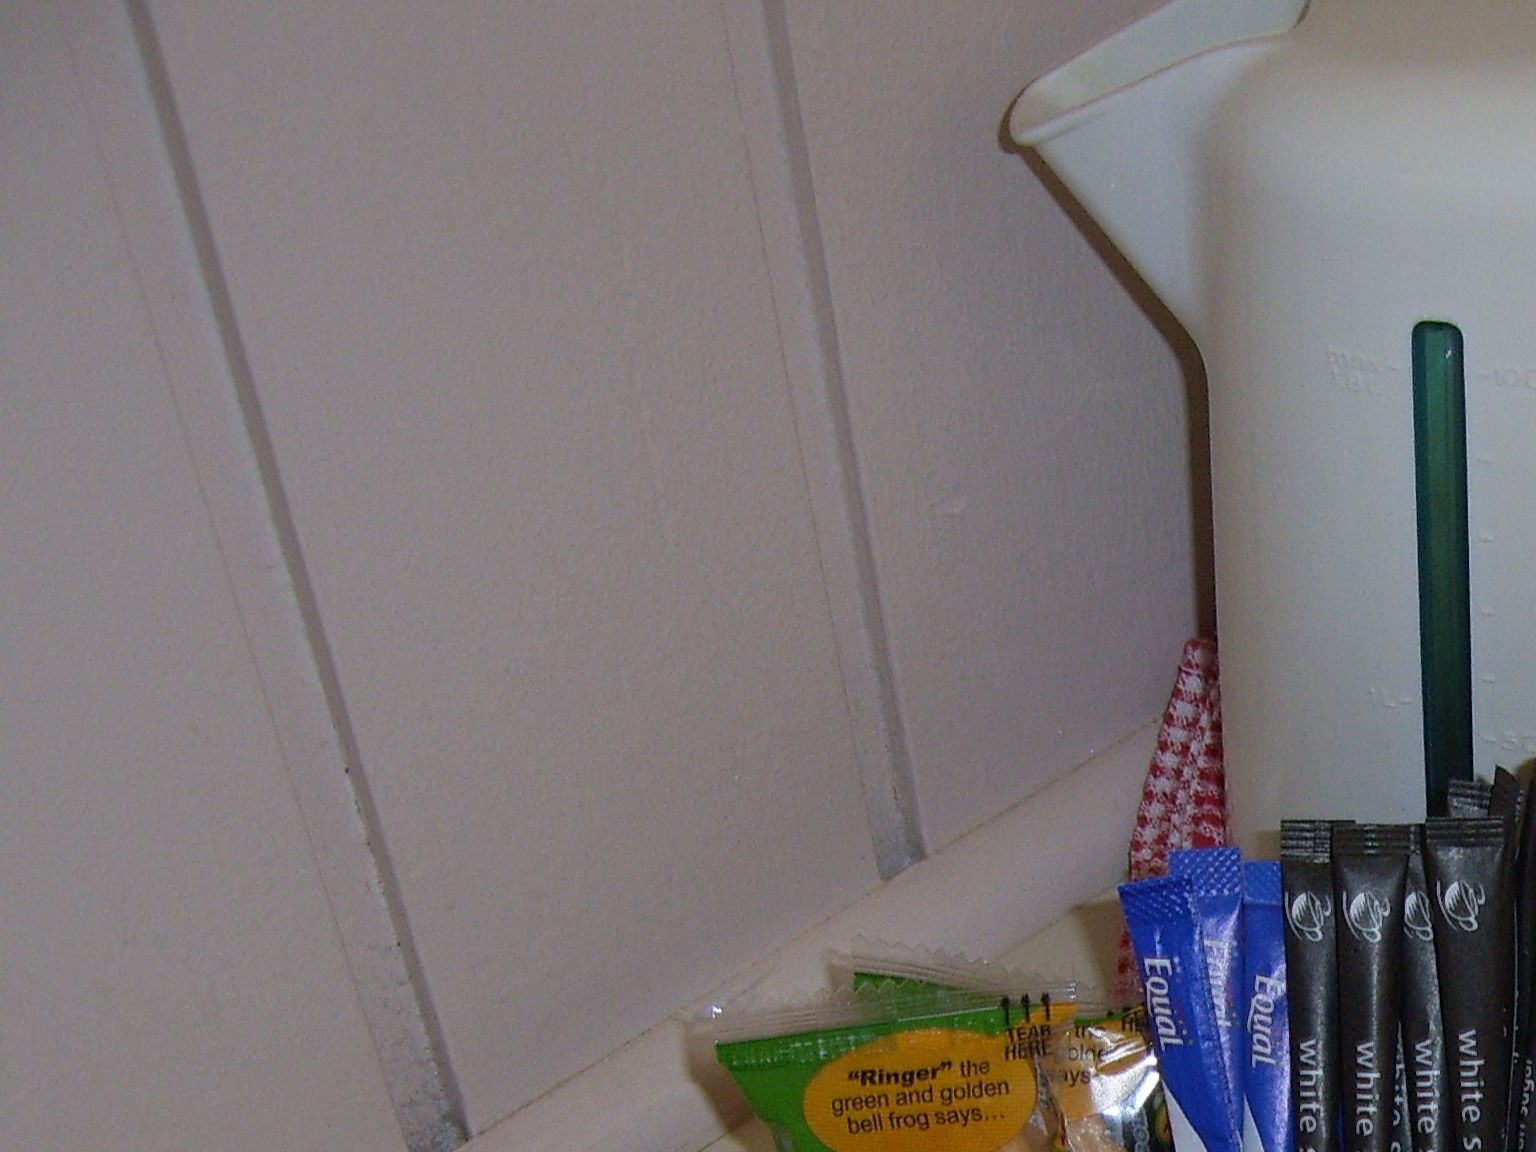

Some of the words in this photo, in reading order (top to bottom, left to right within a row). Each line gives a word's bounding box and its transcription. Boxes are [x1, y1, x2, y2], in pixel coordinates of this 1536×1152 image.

[1005, 1040, 1053, 1062] HERE
[1006, 1024, 1051, 1043] TEAR
[1144, 957, 1185, 1052] Equal
[1247, 974, 1287, 1069] Equal
[831, 1092, 891, 1117] green
[896, 1086, 934, 1107] and
[940, 1080, 1010, 1106] golden
[960, 1059, 991, 1079] the
[1299, 1038, 1328, 1134] white
[1355, 1041, 1381, 1137] white
[1415, 1038, 1441, 1135] white
[1457, 1028, 1485, 1124] white
[847, 1113, 884, 1135] bell
[888, 1110, 930, 1131] frog
